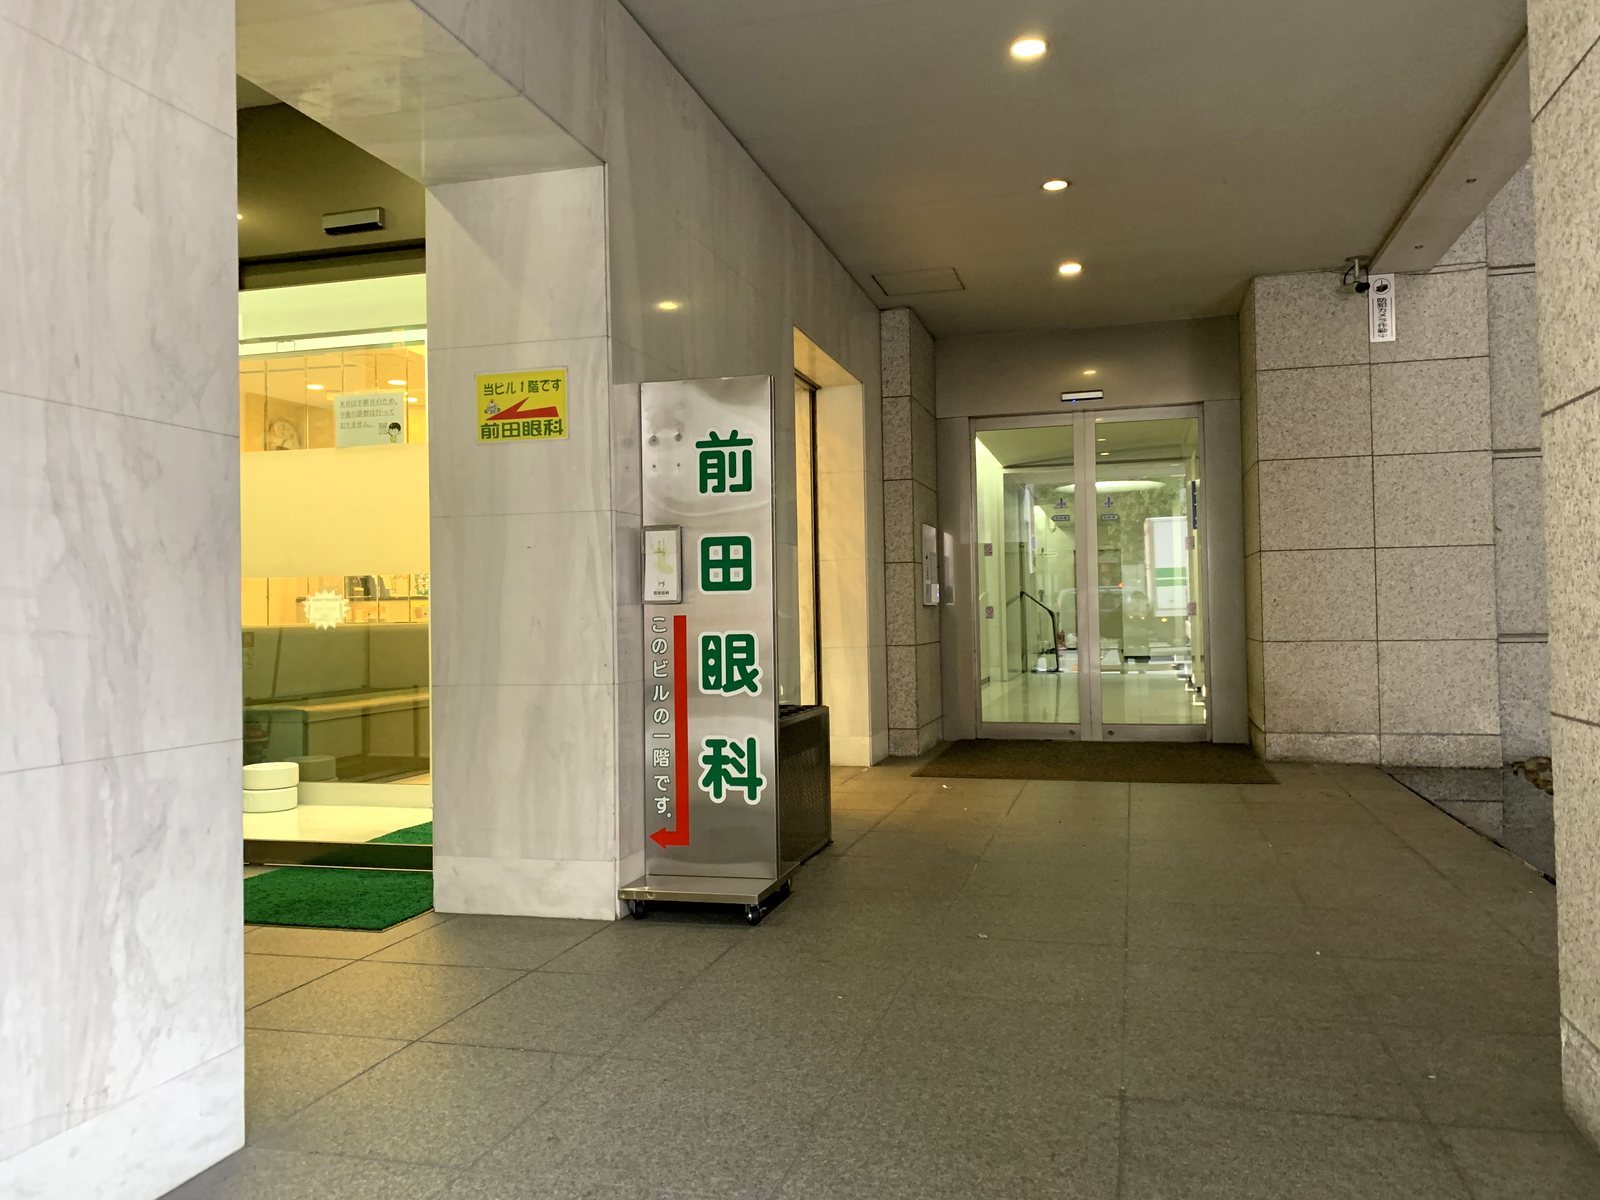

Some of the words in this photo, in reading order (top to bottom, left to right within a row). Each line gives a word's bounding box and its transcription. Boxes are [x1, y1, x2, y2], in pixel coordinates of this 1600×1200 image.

[480, 419, 564, 440] 前田眼科
[651, 615, 672, 819] このビルの一階です。
[694, 428, 765, 802] 前田眼科
